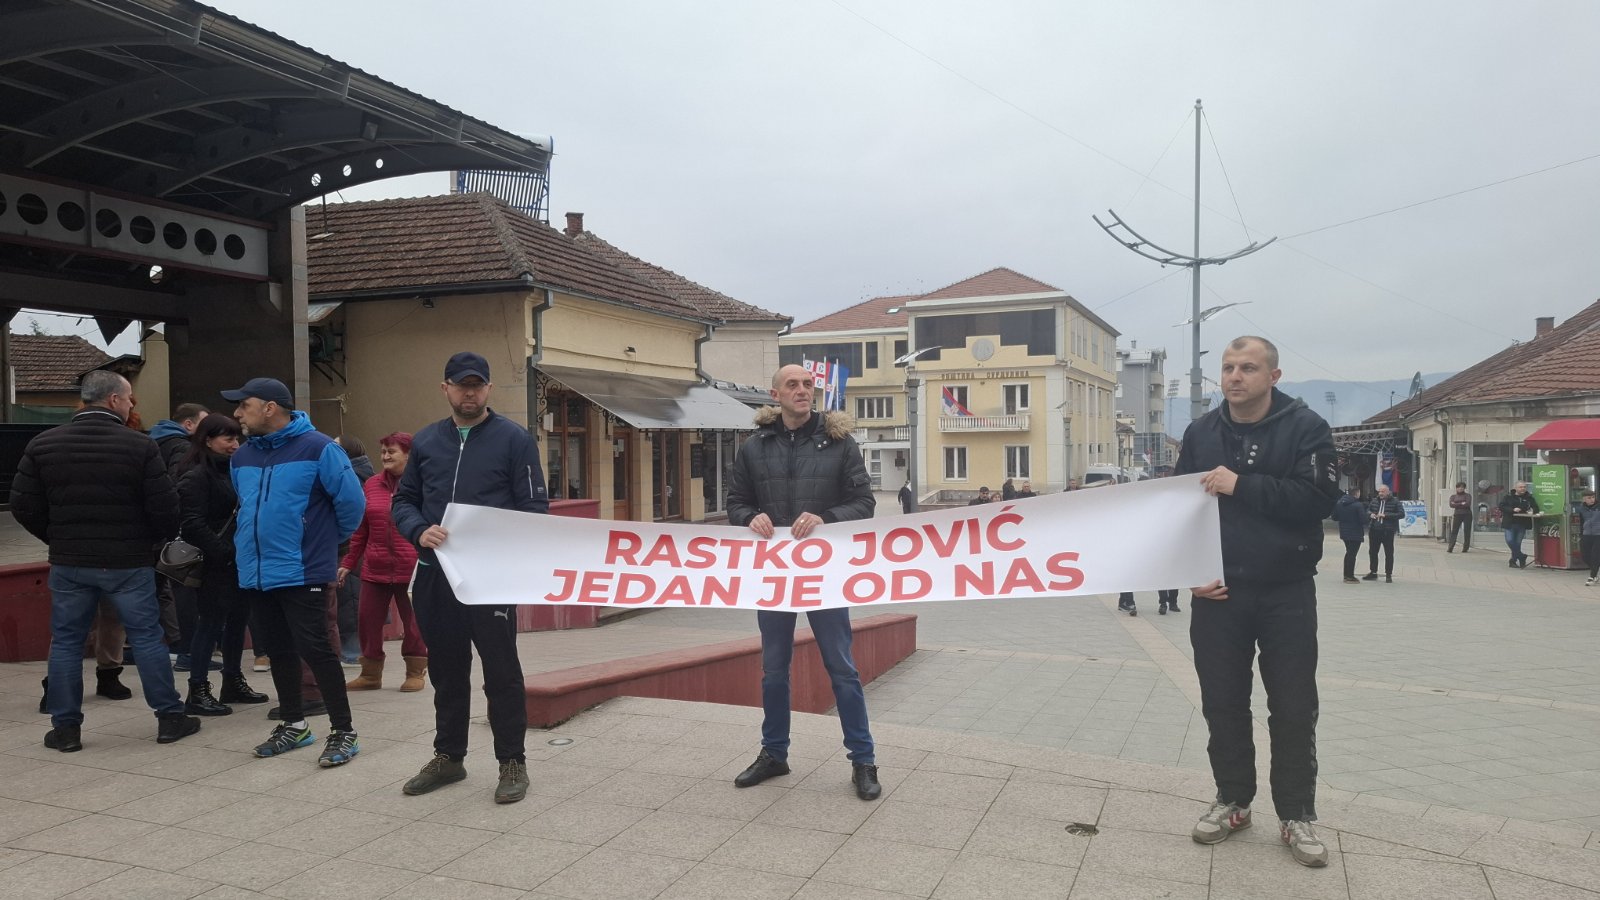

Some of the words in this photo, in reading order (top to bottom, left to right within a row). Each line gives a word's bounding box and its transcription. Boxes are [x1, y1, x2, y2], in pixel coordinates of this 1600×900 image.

[605, 529, 833, 570] RASTKO
[849, 505, 1025, 567] JOVIĆ
[543, 569, 742, 607] JEDAN
[755, 575, 825, 608] JE
[843, 568, 933, 604] OD
[955, 551, 1085, 598] NAS
